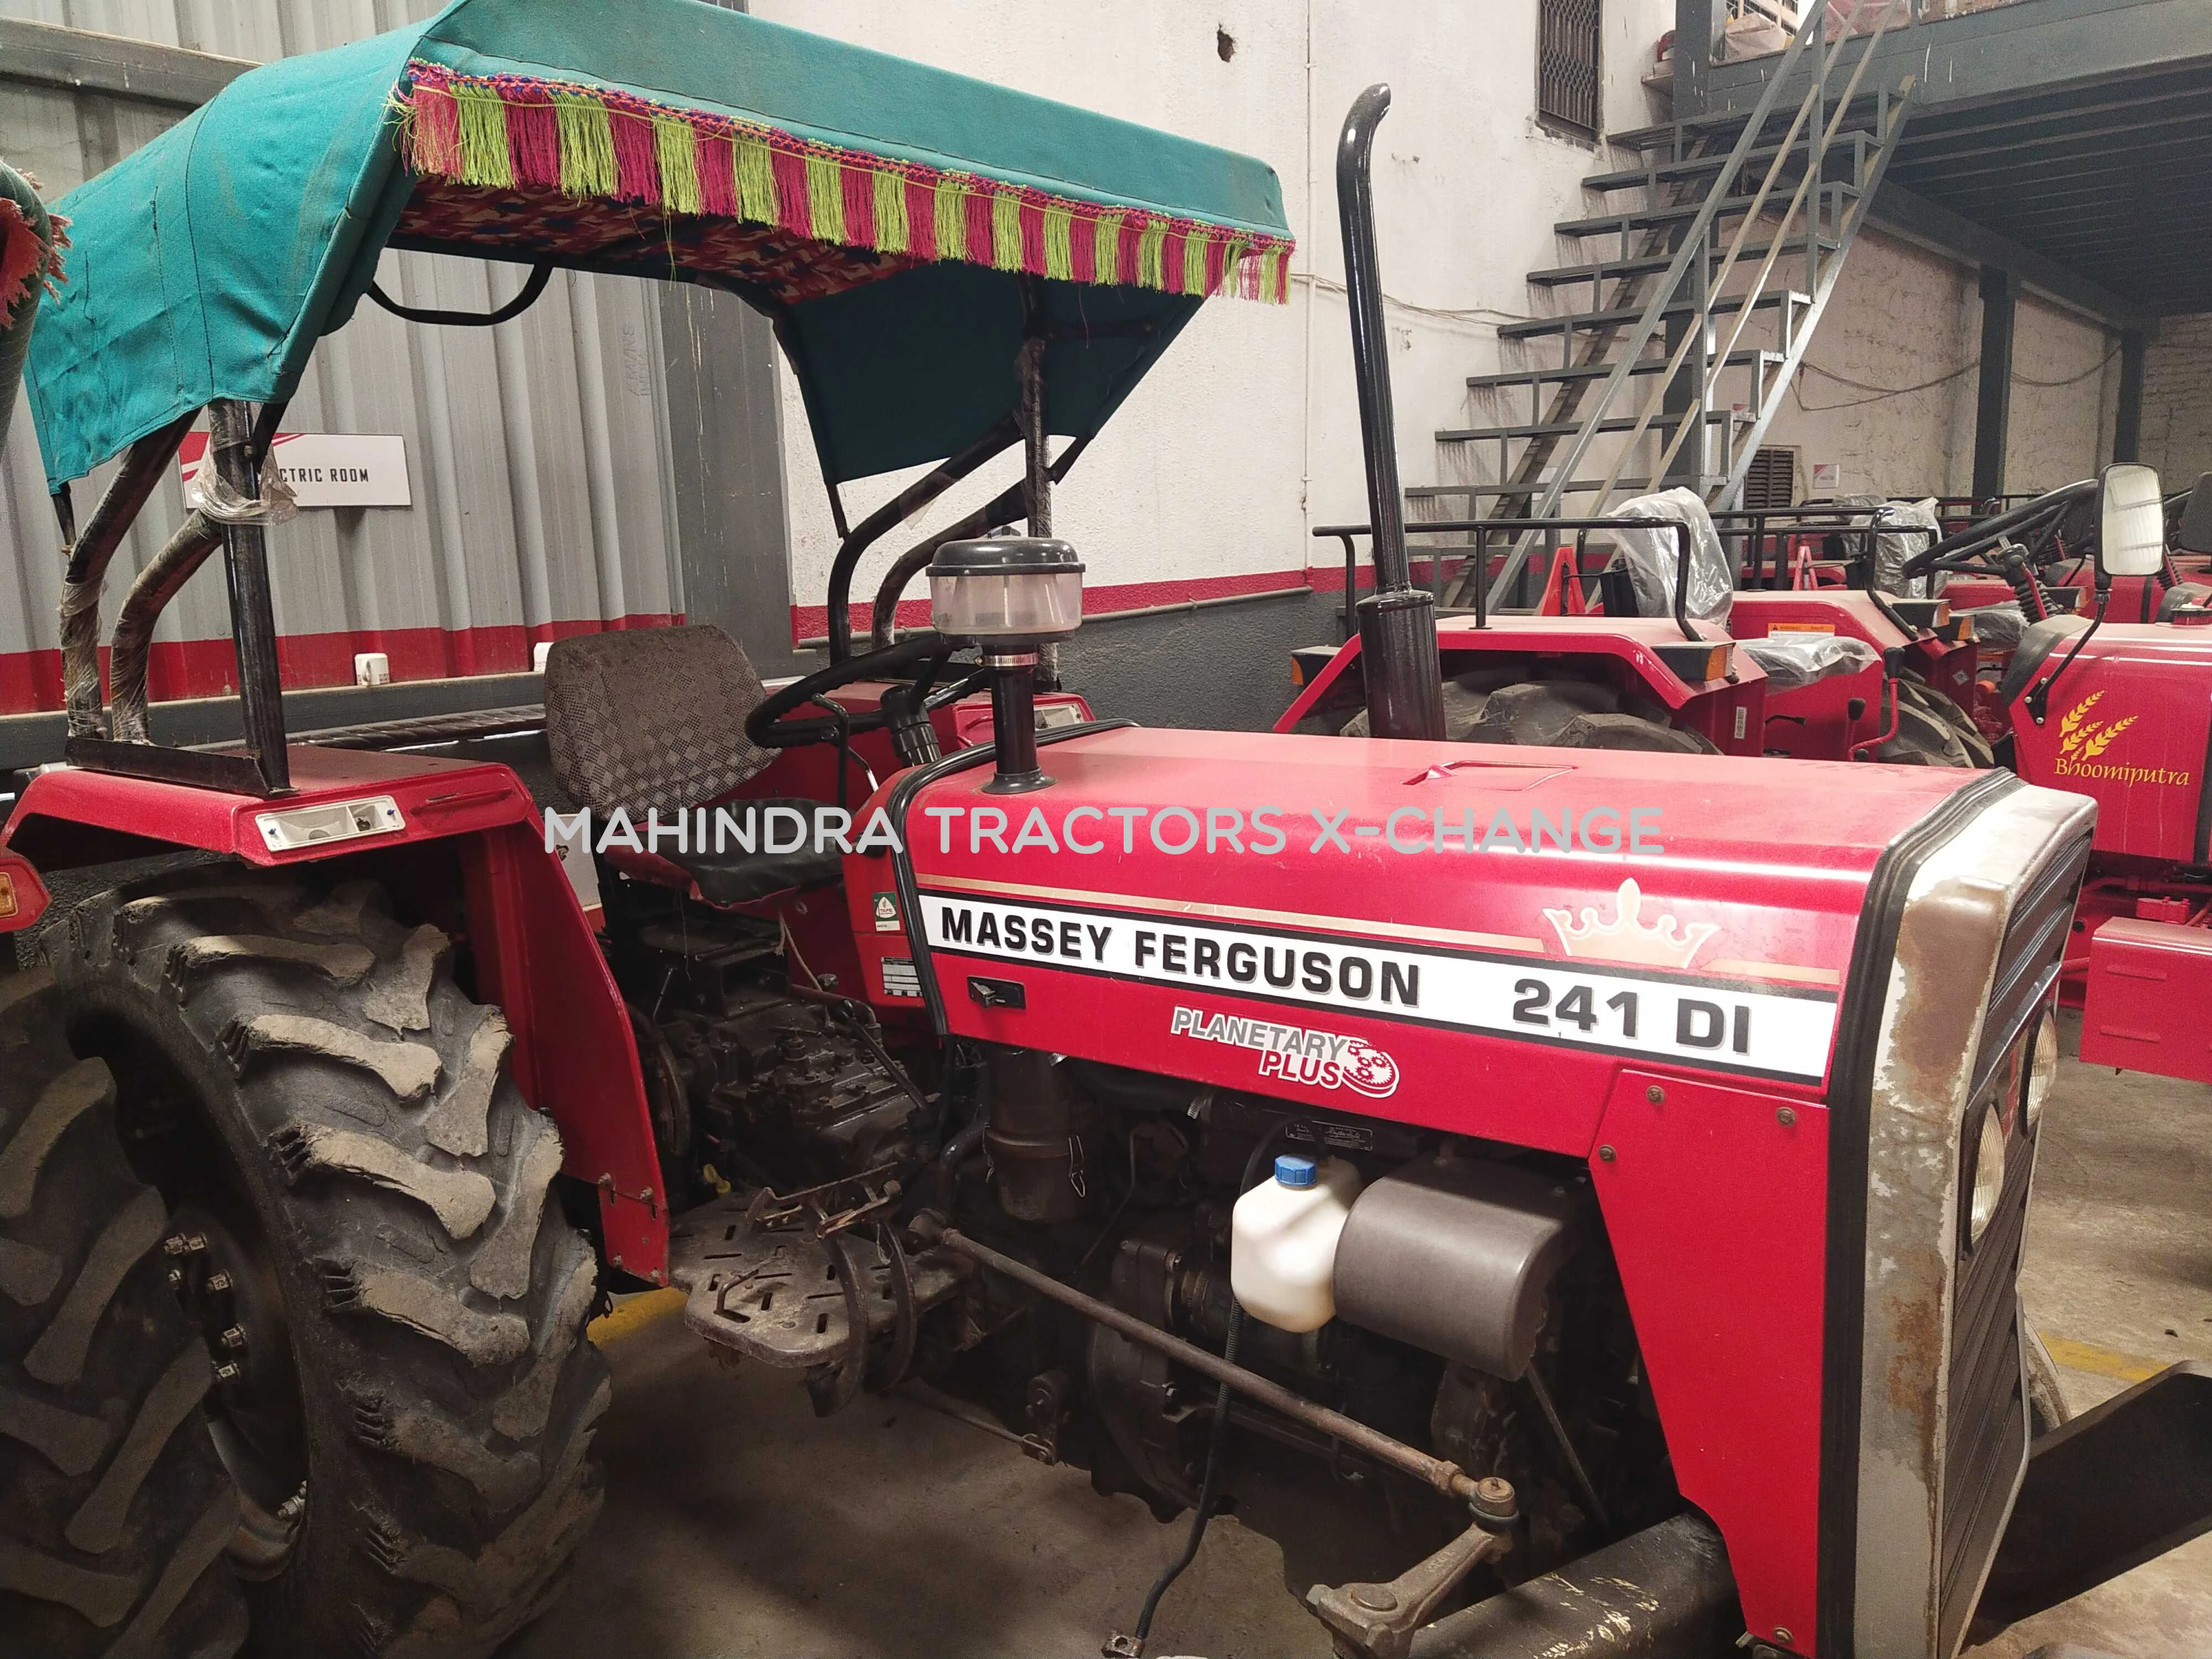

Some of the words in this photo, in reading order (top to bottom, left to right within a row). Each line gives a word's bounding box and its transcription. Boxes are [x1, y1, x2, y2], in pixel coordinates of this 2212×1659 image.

[279, 468, 322, 482] CTRIC
[330, 468, 369, 482] ROOM
[2053, 757, 2189, 787] Bhoomiputra
[942, 906, 1112, 963] MASSEY
[1135, 930, 1419, 1008] FERGUSON
[1512, 978, 1639, 1040] 241
[1676, 998, 1751, 1056] DI
[1171, 1006, 1348, 1061] PLANETARY
[1259, 1051, 1342, 1088] PLUS
